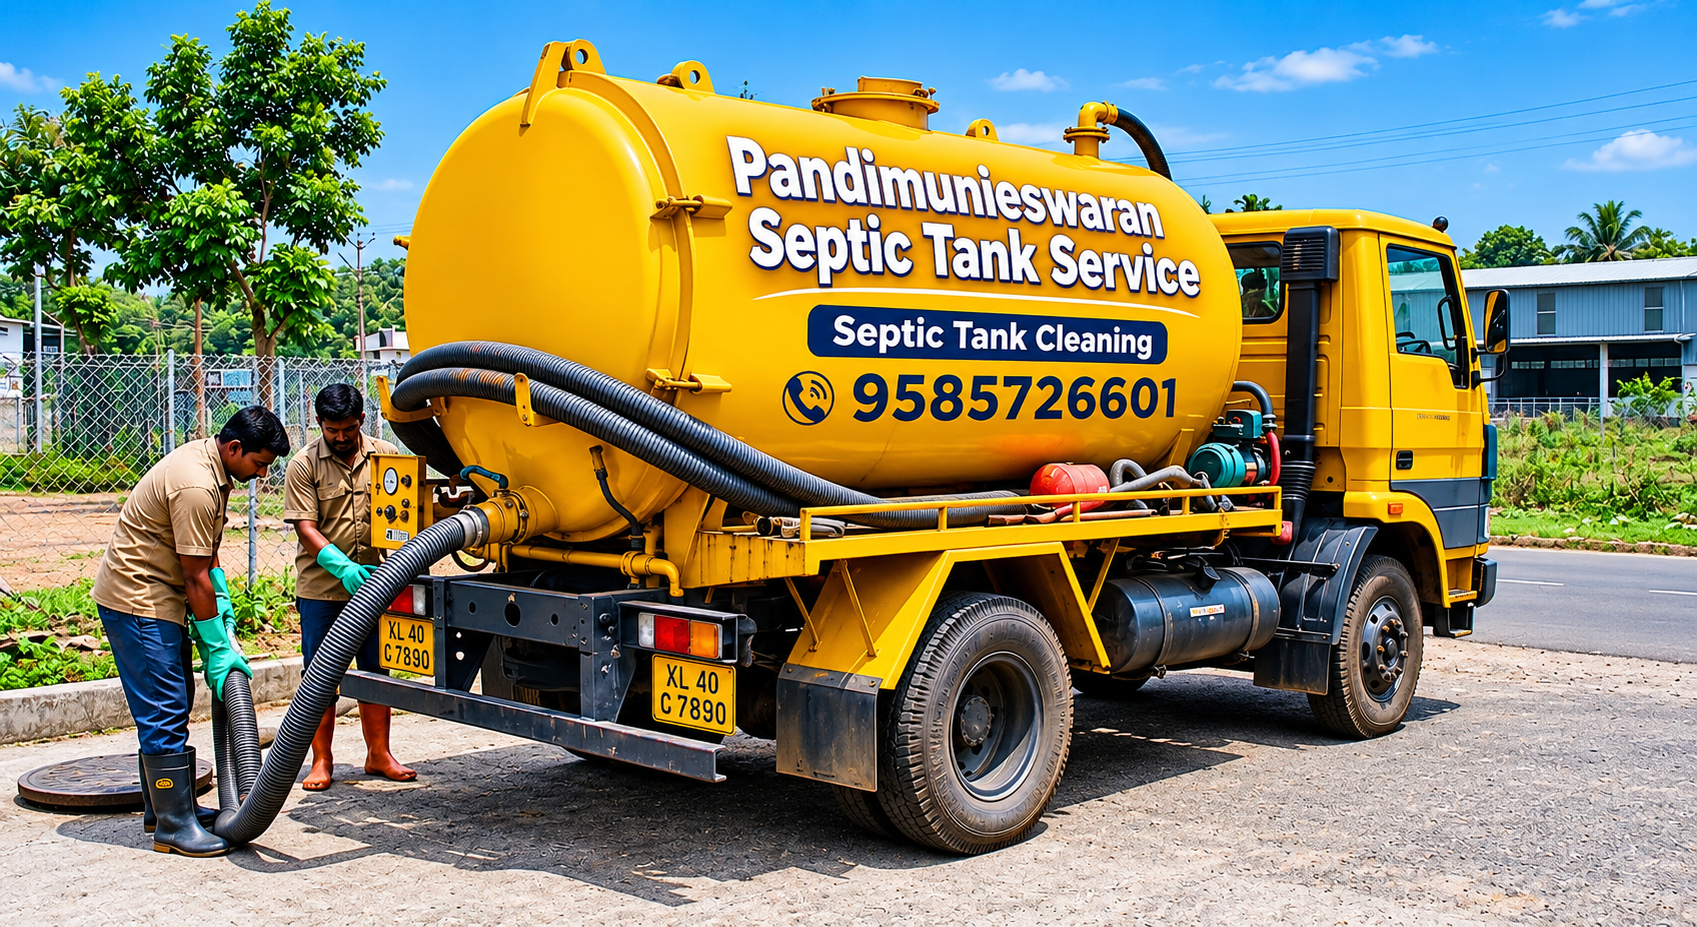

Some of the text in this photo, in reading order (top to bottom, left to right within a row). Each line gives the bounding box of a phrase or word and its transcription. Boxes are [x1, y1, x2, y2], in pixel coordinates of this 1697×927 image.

[725, 135, 1164, 238] Pandimunieswaran
[749, 207, 1200, 297] Septic Tank Service
[832, 314, 1153, 360] Septic Tank Cleaning
[852, 373, 1177, 421] 9585726601
[388, 620, 424, 644] XL 40
[384, 643, 430, 670] C 7890
[666, 663, 719, 695] XL 40
[660, 691, 727, 726] C 7890
